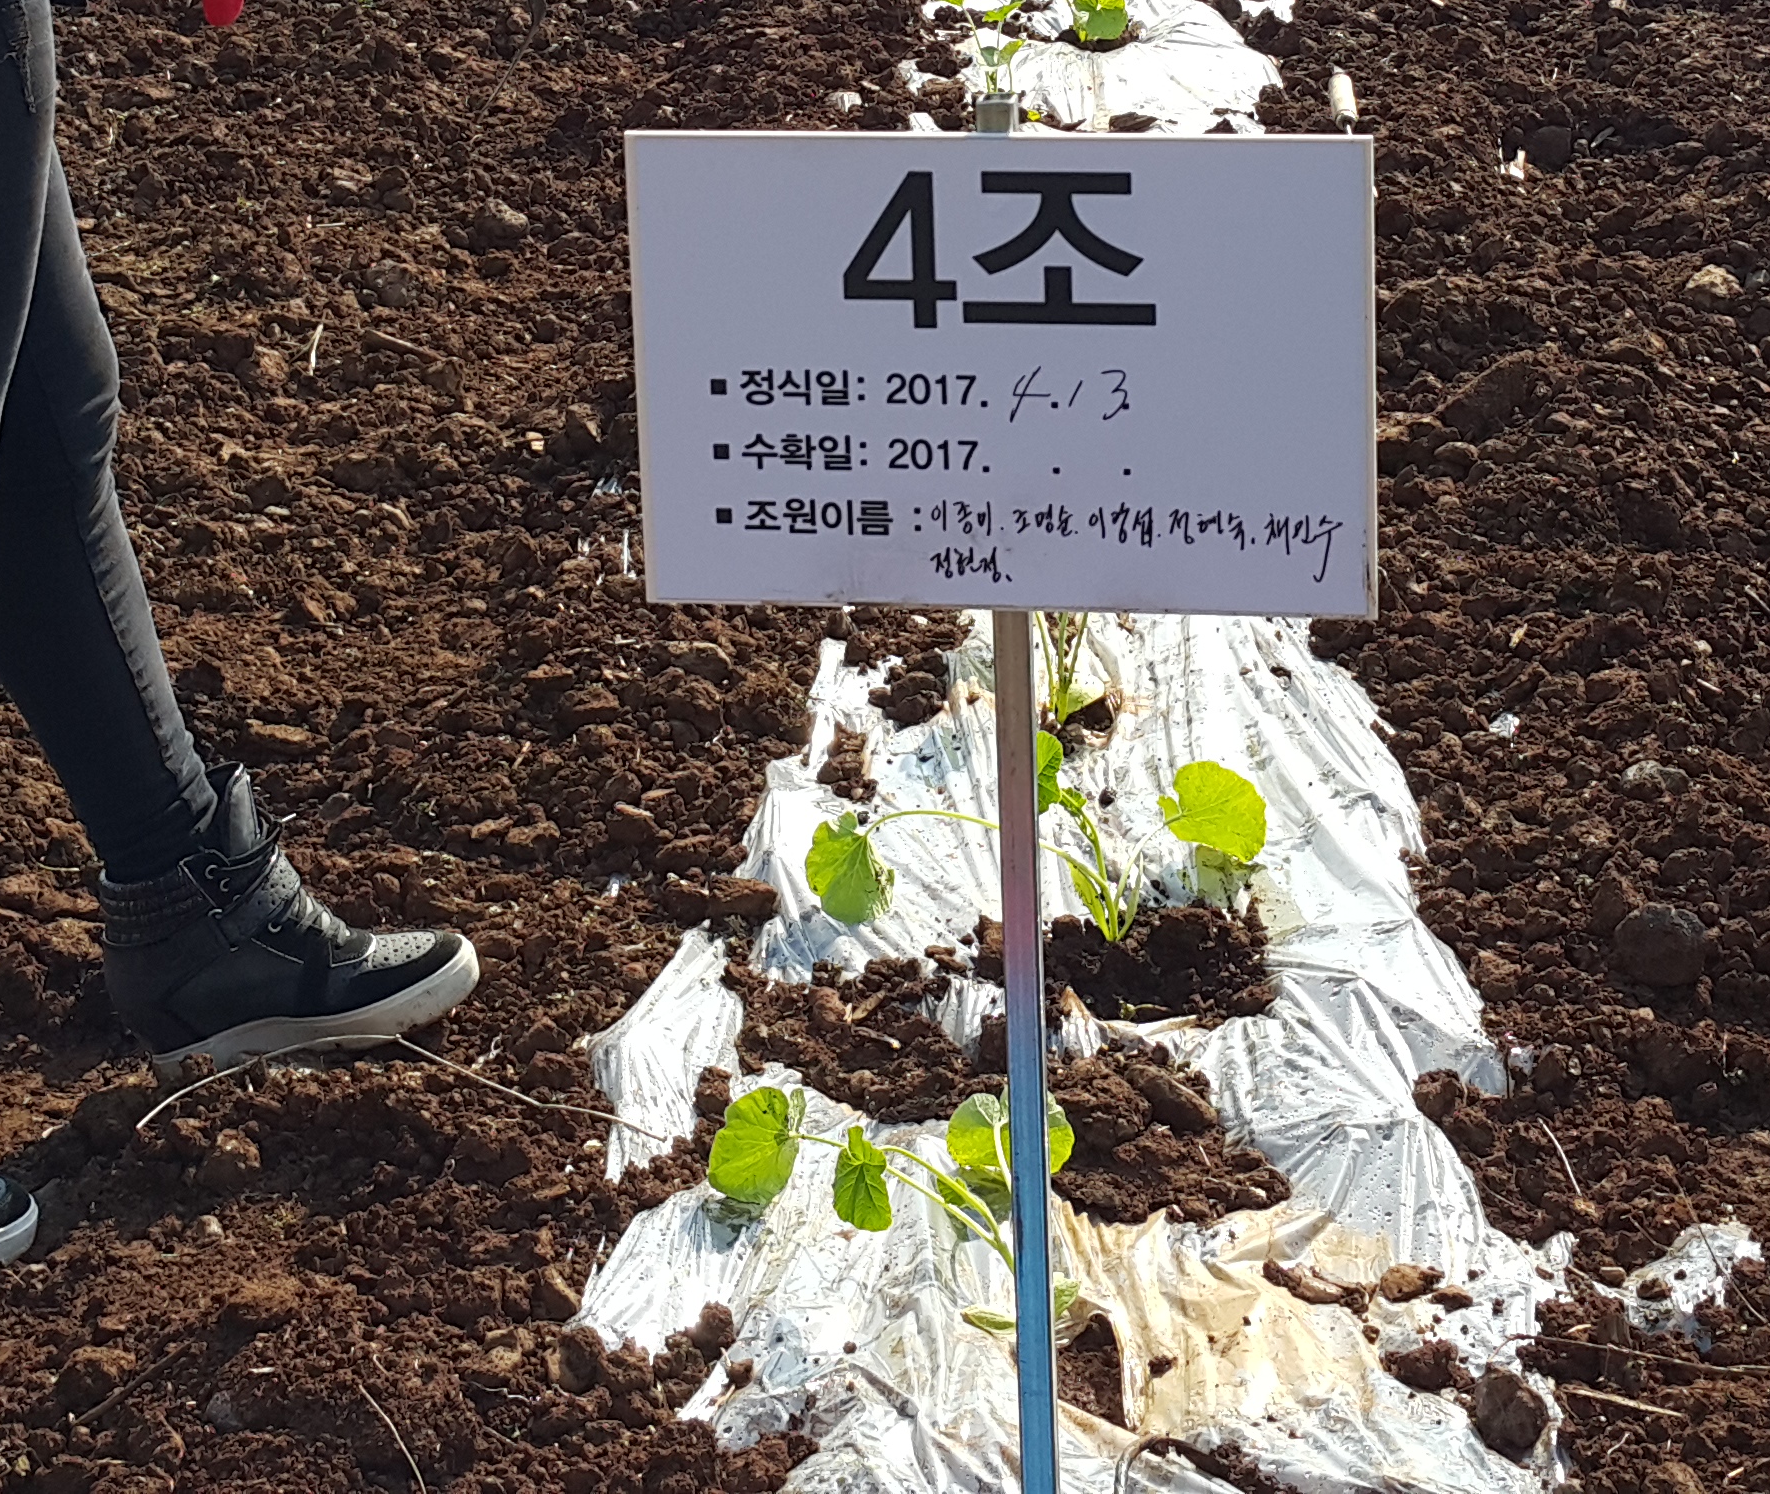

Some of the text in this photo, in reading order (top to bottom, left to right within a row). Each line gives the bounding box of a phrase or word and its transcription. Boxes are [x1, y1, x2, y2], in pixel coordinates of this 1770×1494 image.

[842, 170, 1157, 330] 4조
[738, 368, 989, 408] 정식일: 2017.
[740, 433, 868, 471] 수확일:
[887, 438, 991, 473] 2017.
[743, 497, 894, 536] 조원이름
